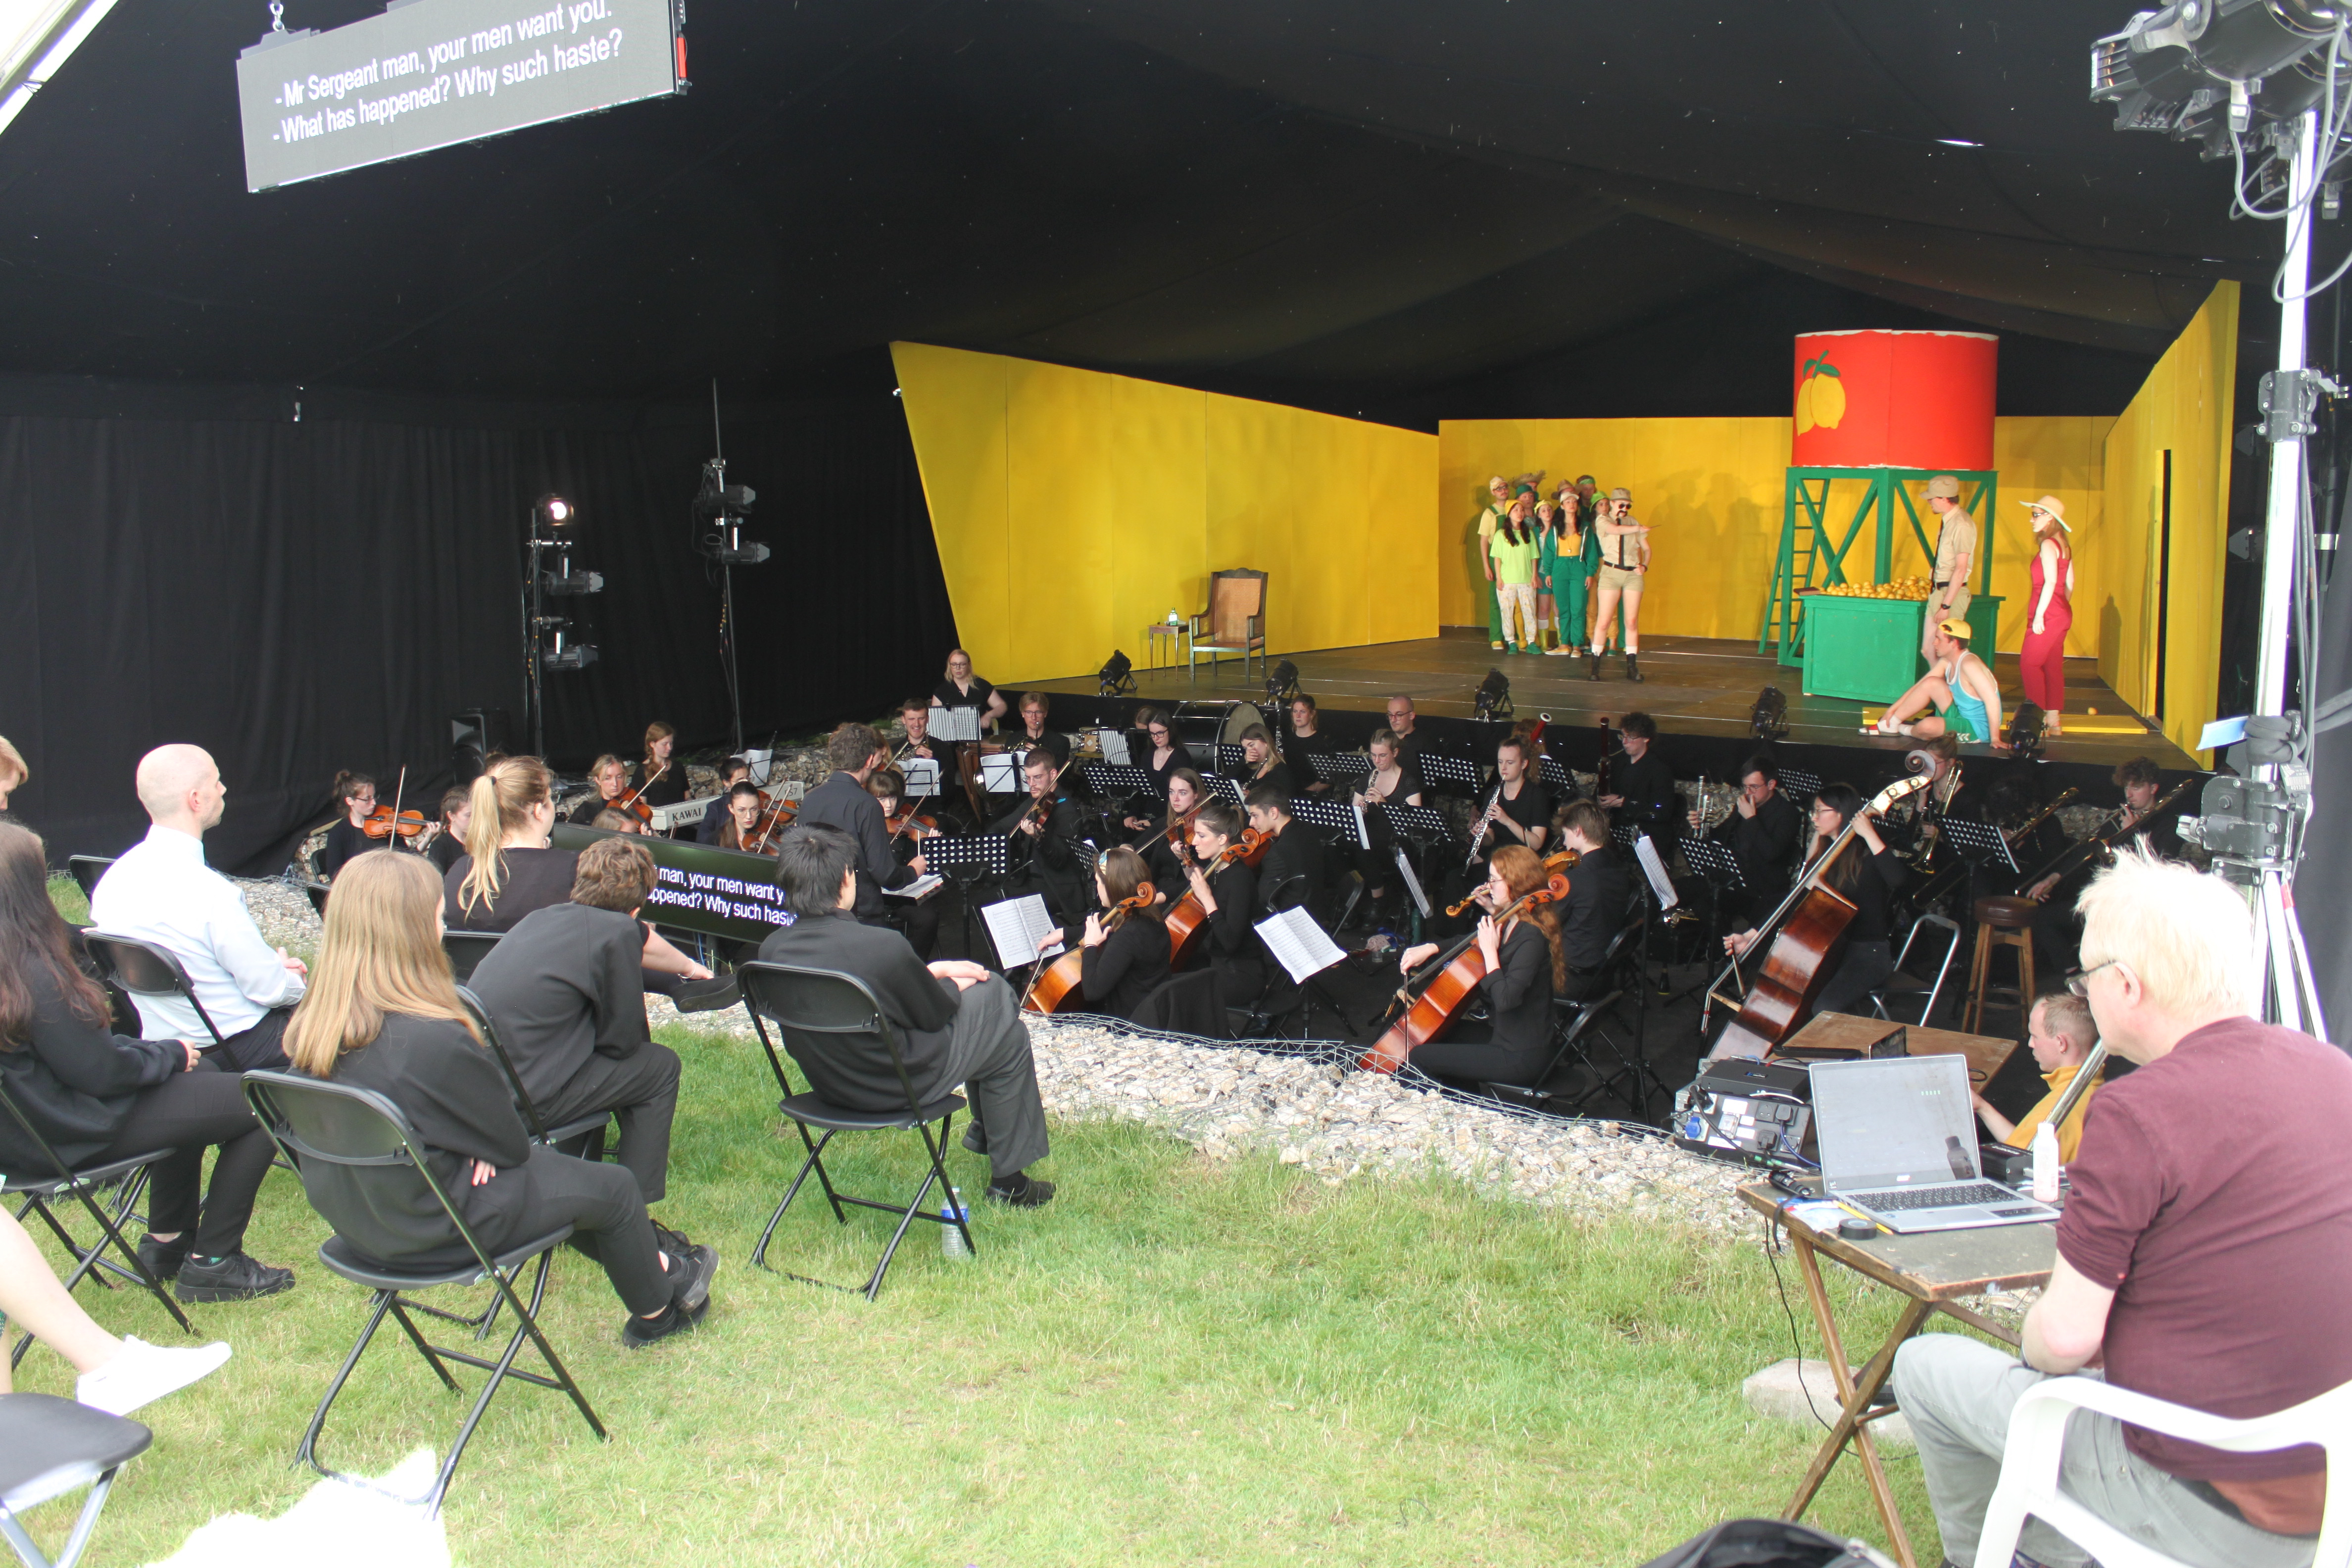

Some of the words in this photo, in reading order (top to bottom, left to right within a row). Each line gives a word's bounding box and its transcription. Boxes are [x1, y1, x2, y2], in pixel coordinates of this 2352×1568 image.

[308, 58, 379, 100] Sergeant
[383, 52, 425, 80] man,
[428, 37, 467, 73] your
[472, 25, 512, 54] men
[517, 3, 564, 41] want
[569, 0, 612, 34] you.
[327, 108, 356, 133] has
[359, 75, 450, 126] happened?
[454, 66, 497, 97] Why
[502, 49, 548, 85] such
[554, 28, 622, 72] haste?
[672, 808, 701, 821] KAWAI
[659, 867, 687, 887] man,
[688, 873, 715, 889] your
[717, 878, 743, 894] men
[744, 882, 775, 901] want
[704, 894, 732, 918] Why
[733, 903, 762, 921] such
